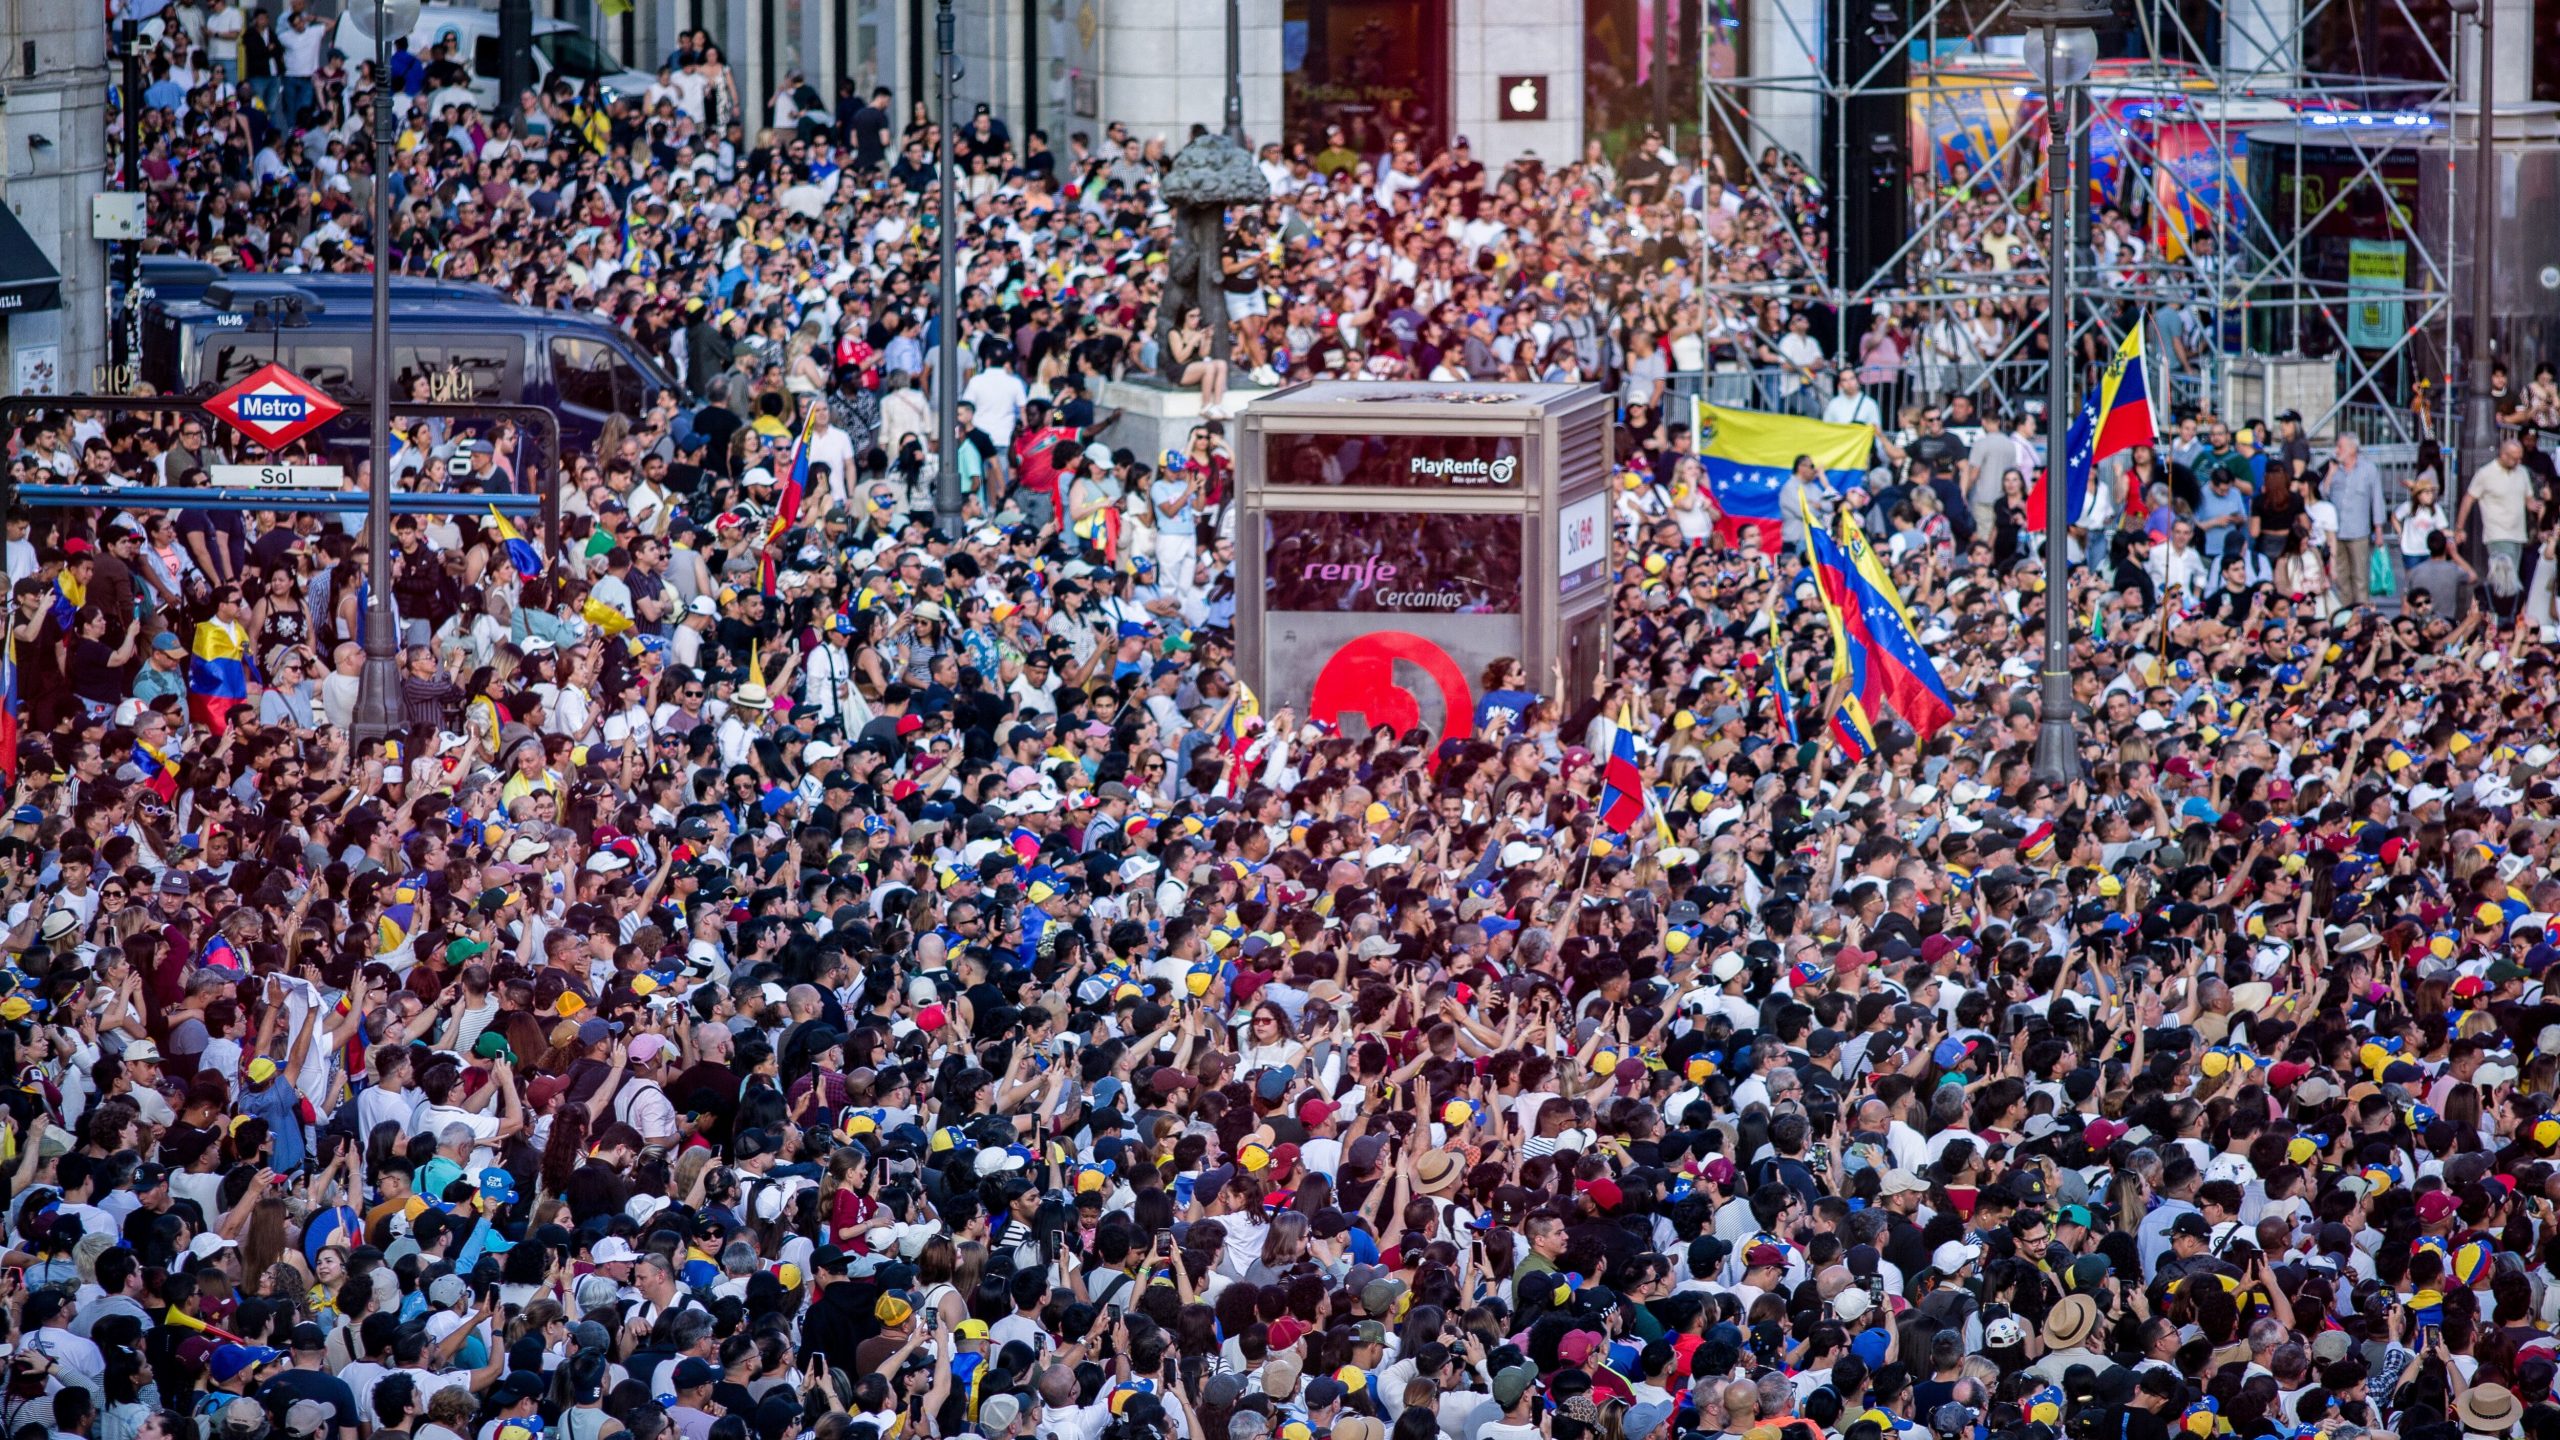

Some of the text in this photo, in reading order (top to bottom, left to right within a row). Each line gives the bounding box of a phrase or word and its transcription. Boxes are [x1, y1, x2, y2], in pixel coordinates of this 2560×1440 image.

[243, 397, 302, 417] Metro
[261, 468, 293, 484] Sol
[1411, 457, 1488, 477] PlayRenfe
[1567, 519, 1580, 555] Sol
[1303, 554, 1397, 591] renfe
[1375, 587, 1463, 607] Cercanías
